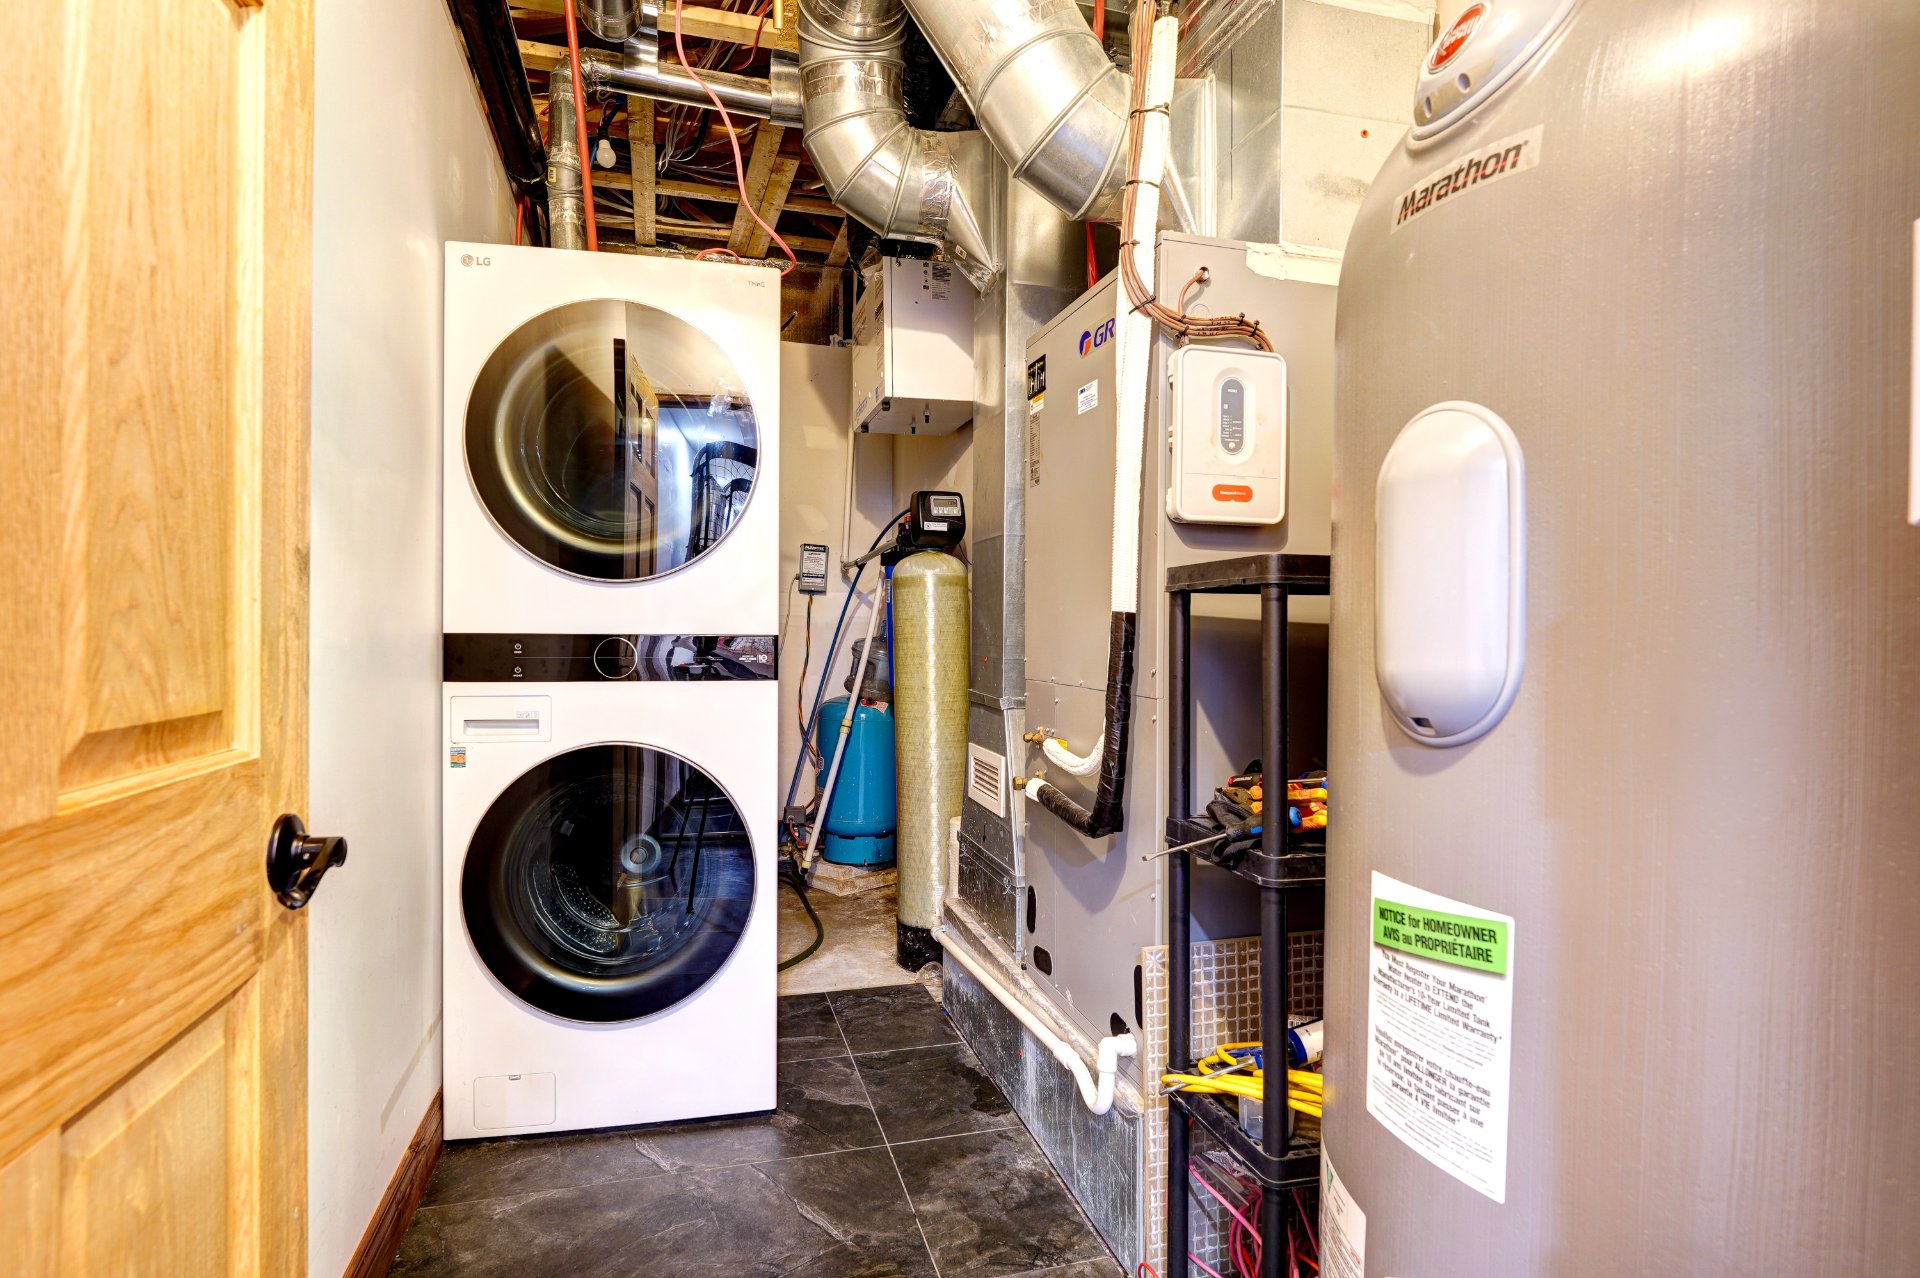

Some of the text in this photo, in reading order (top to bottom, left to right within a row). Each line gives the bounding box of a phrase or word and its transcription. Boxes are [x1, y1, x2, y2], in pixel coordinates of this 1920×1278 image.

[1397, 143, 1523, 225] Marathon
[476, 257, 491, 266] LG
[1379, 907, 1498, 944] NOTICE for HOMEOWNER
[1383, 926, 1494, 964] AVIS au PROPRIÉTAIRE
[1405, 993, 1433, 1014] LIFETIME
[1433, 1007, 1460, 1027] Limited
[1432, 985, 1459, 1004] EXTEND
[1461, 998, 1474, 1010] the
[1443, 1001, 1470, 1020] Limited
[1472, 1013, 1491, 1029] Tank
[1414, 1062, 1447, 1087] ALLONGER
